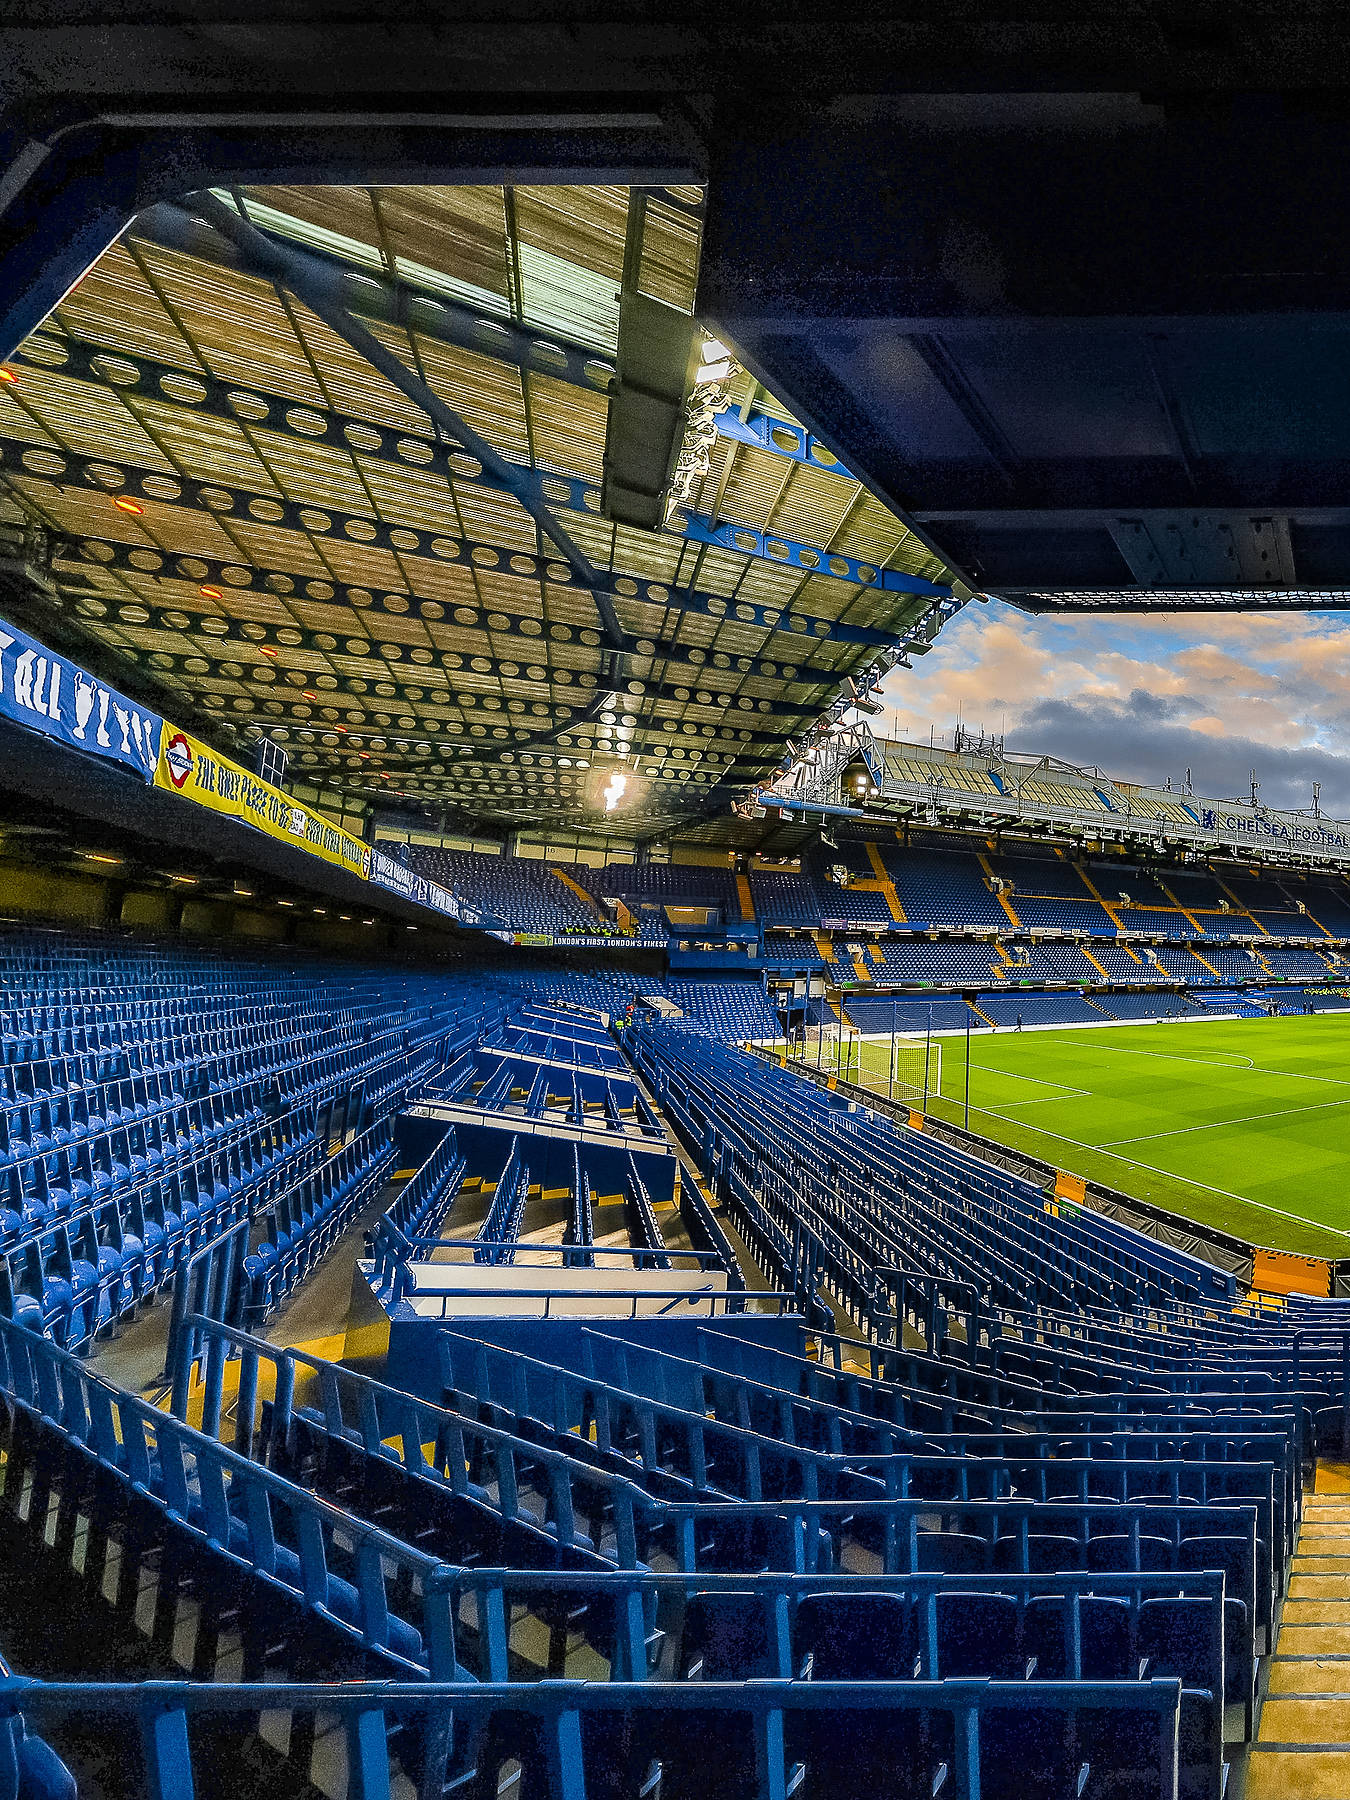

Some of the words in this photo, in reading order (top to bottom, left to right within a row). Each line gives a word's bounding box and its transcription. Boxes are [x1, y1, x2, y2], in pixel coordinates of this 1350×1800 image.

[14, 649, 61, 721] ALL
[195, 755, 215, 792] THE
[1226, 816, 1289, 837] CHELSEA
[554, 936, 586, 946] LONDON'S
[643, 939, 668, 948] FINEST
